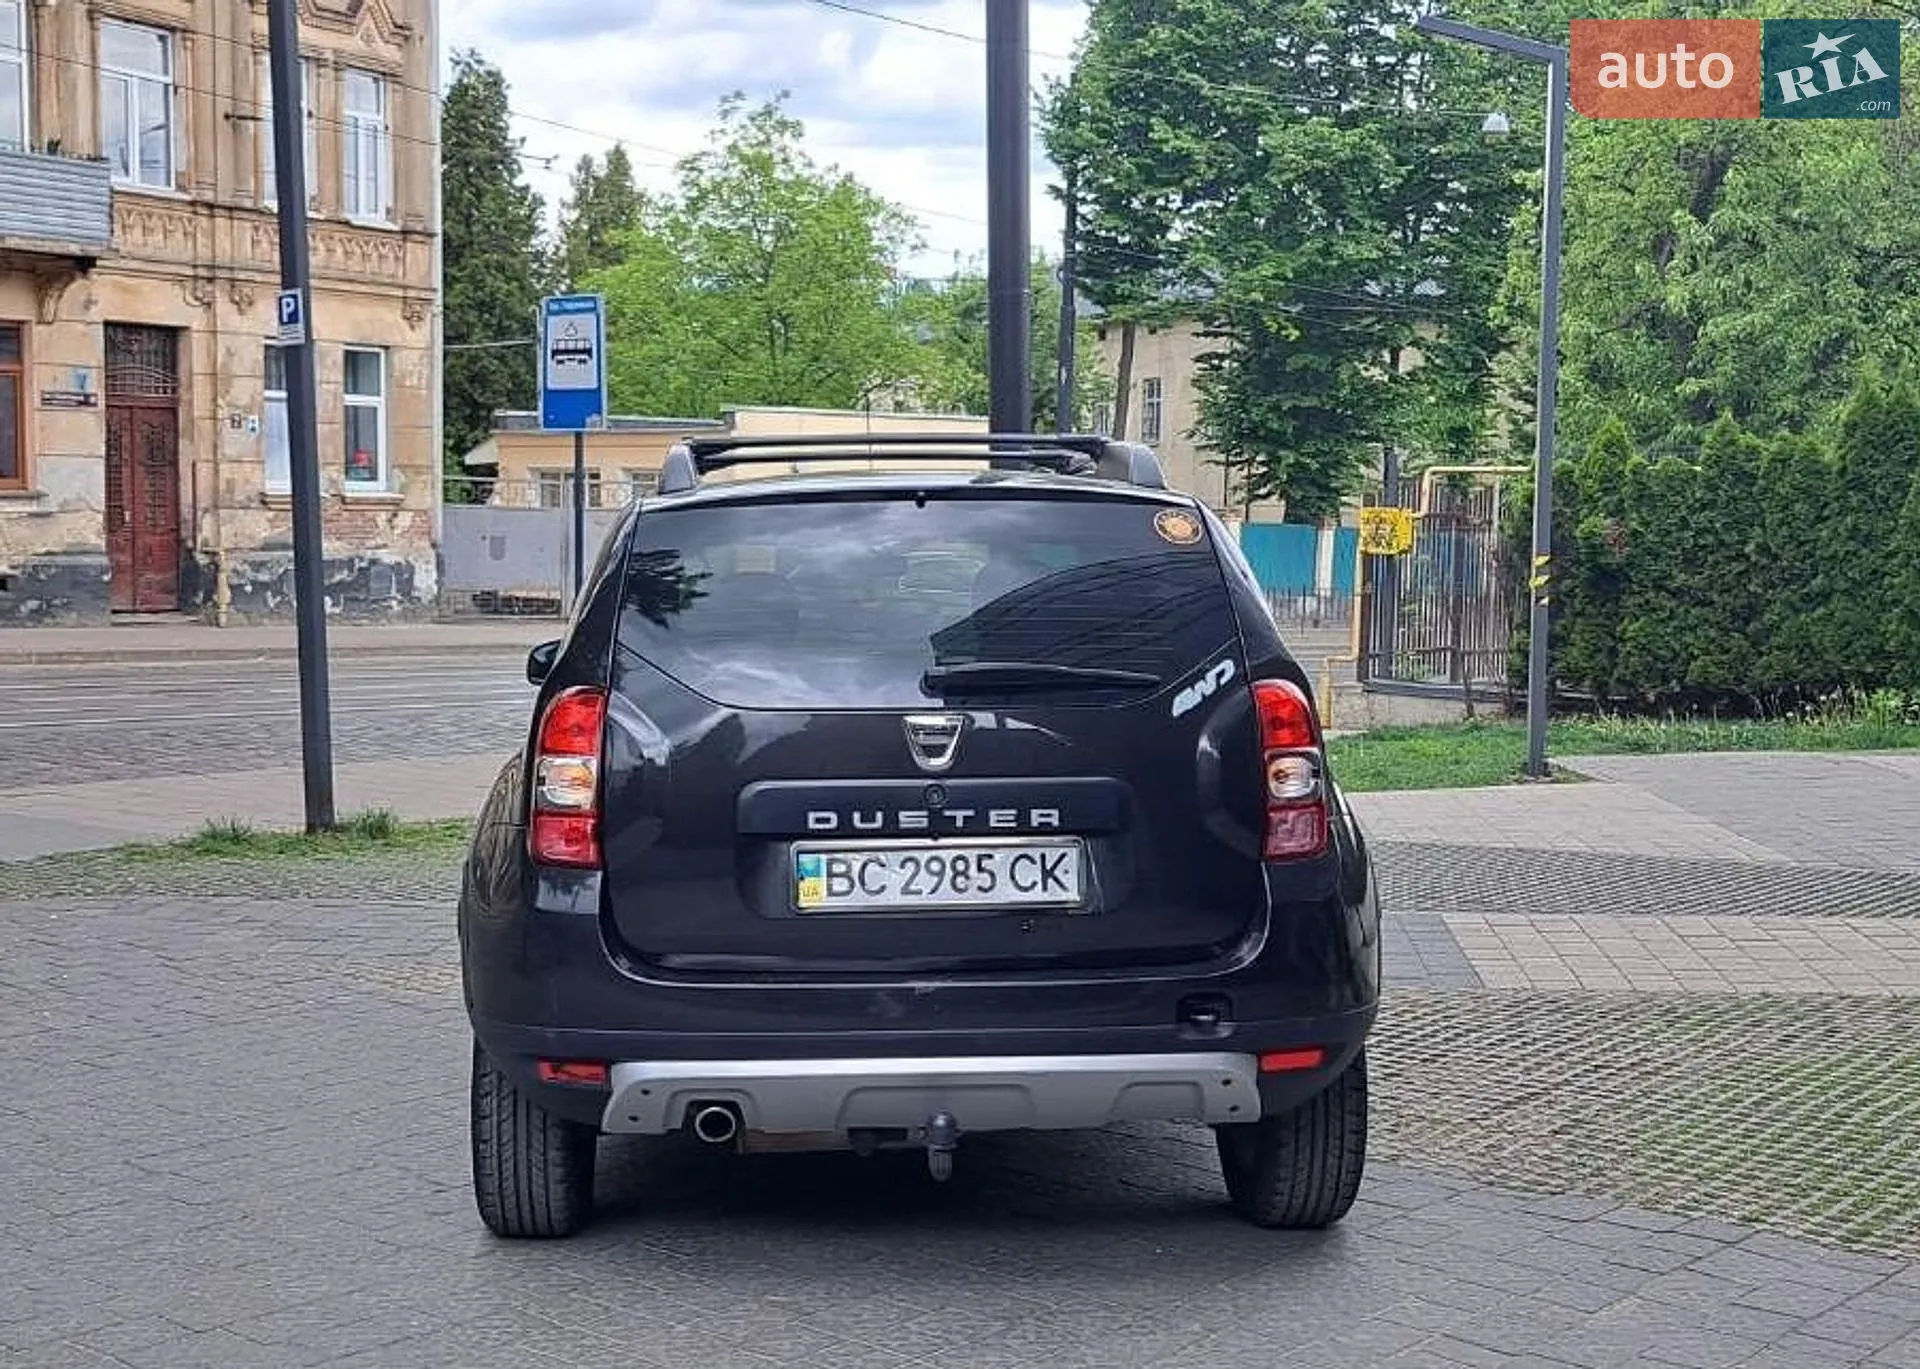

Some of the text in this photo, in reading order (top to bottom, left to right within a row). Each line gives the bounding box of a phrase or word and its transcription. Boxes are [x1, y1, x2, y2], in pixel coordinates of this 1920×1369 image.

[282, 297, 296, 323] P
[806, 808, 1061, 831] DUSTER
[825, 852, 1071, 898] BC 2985 CK
